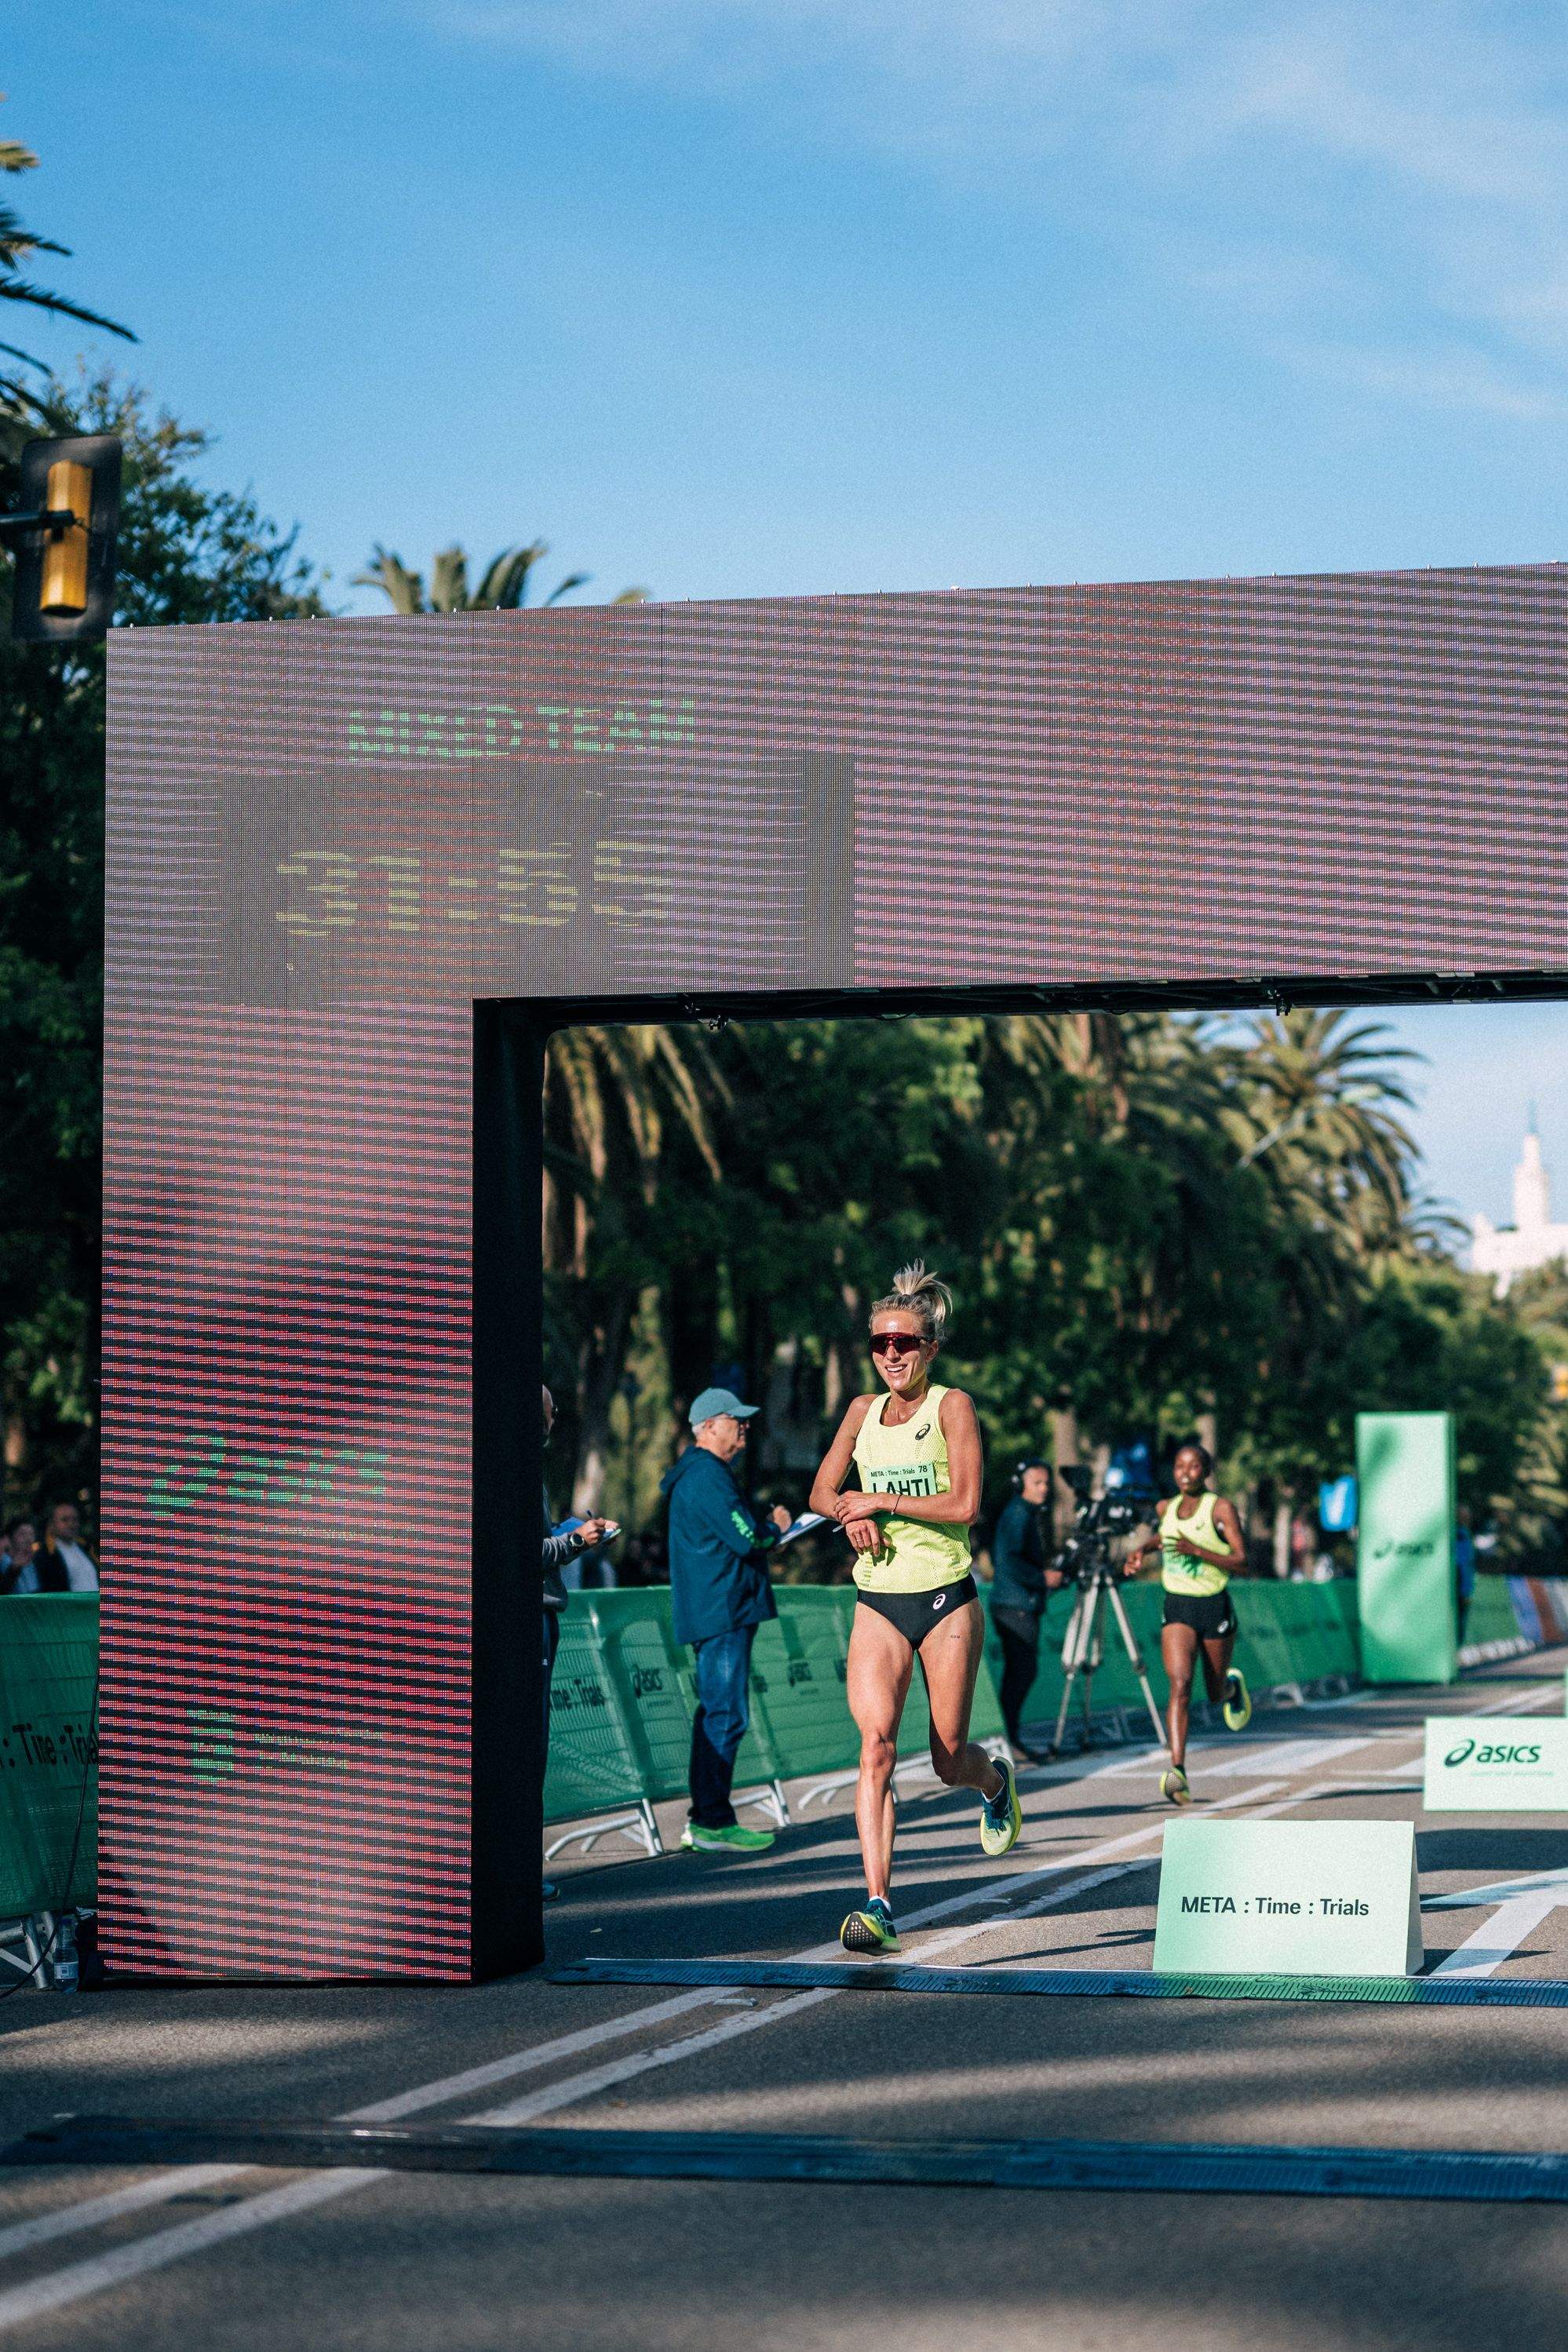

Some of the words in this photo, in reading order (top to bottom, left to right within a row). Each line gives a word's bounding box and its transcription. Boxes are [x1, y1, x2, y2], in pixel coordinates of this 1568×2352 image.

[348, 705, 523, 761] MIXED
[538, 698, 695, 753] TEAM
[12, 1723, 57, 1766] Time
[1476, 1745, 1541, 1763] asics
[1180, 1896, 1237, 1913] META
[1255, 1897, 1301, 1915] Time
[1320, 1898, 1369, 1916] Trials
